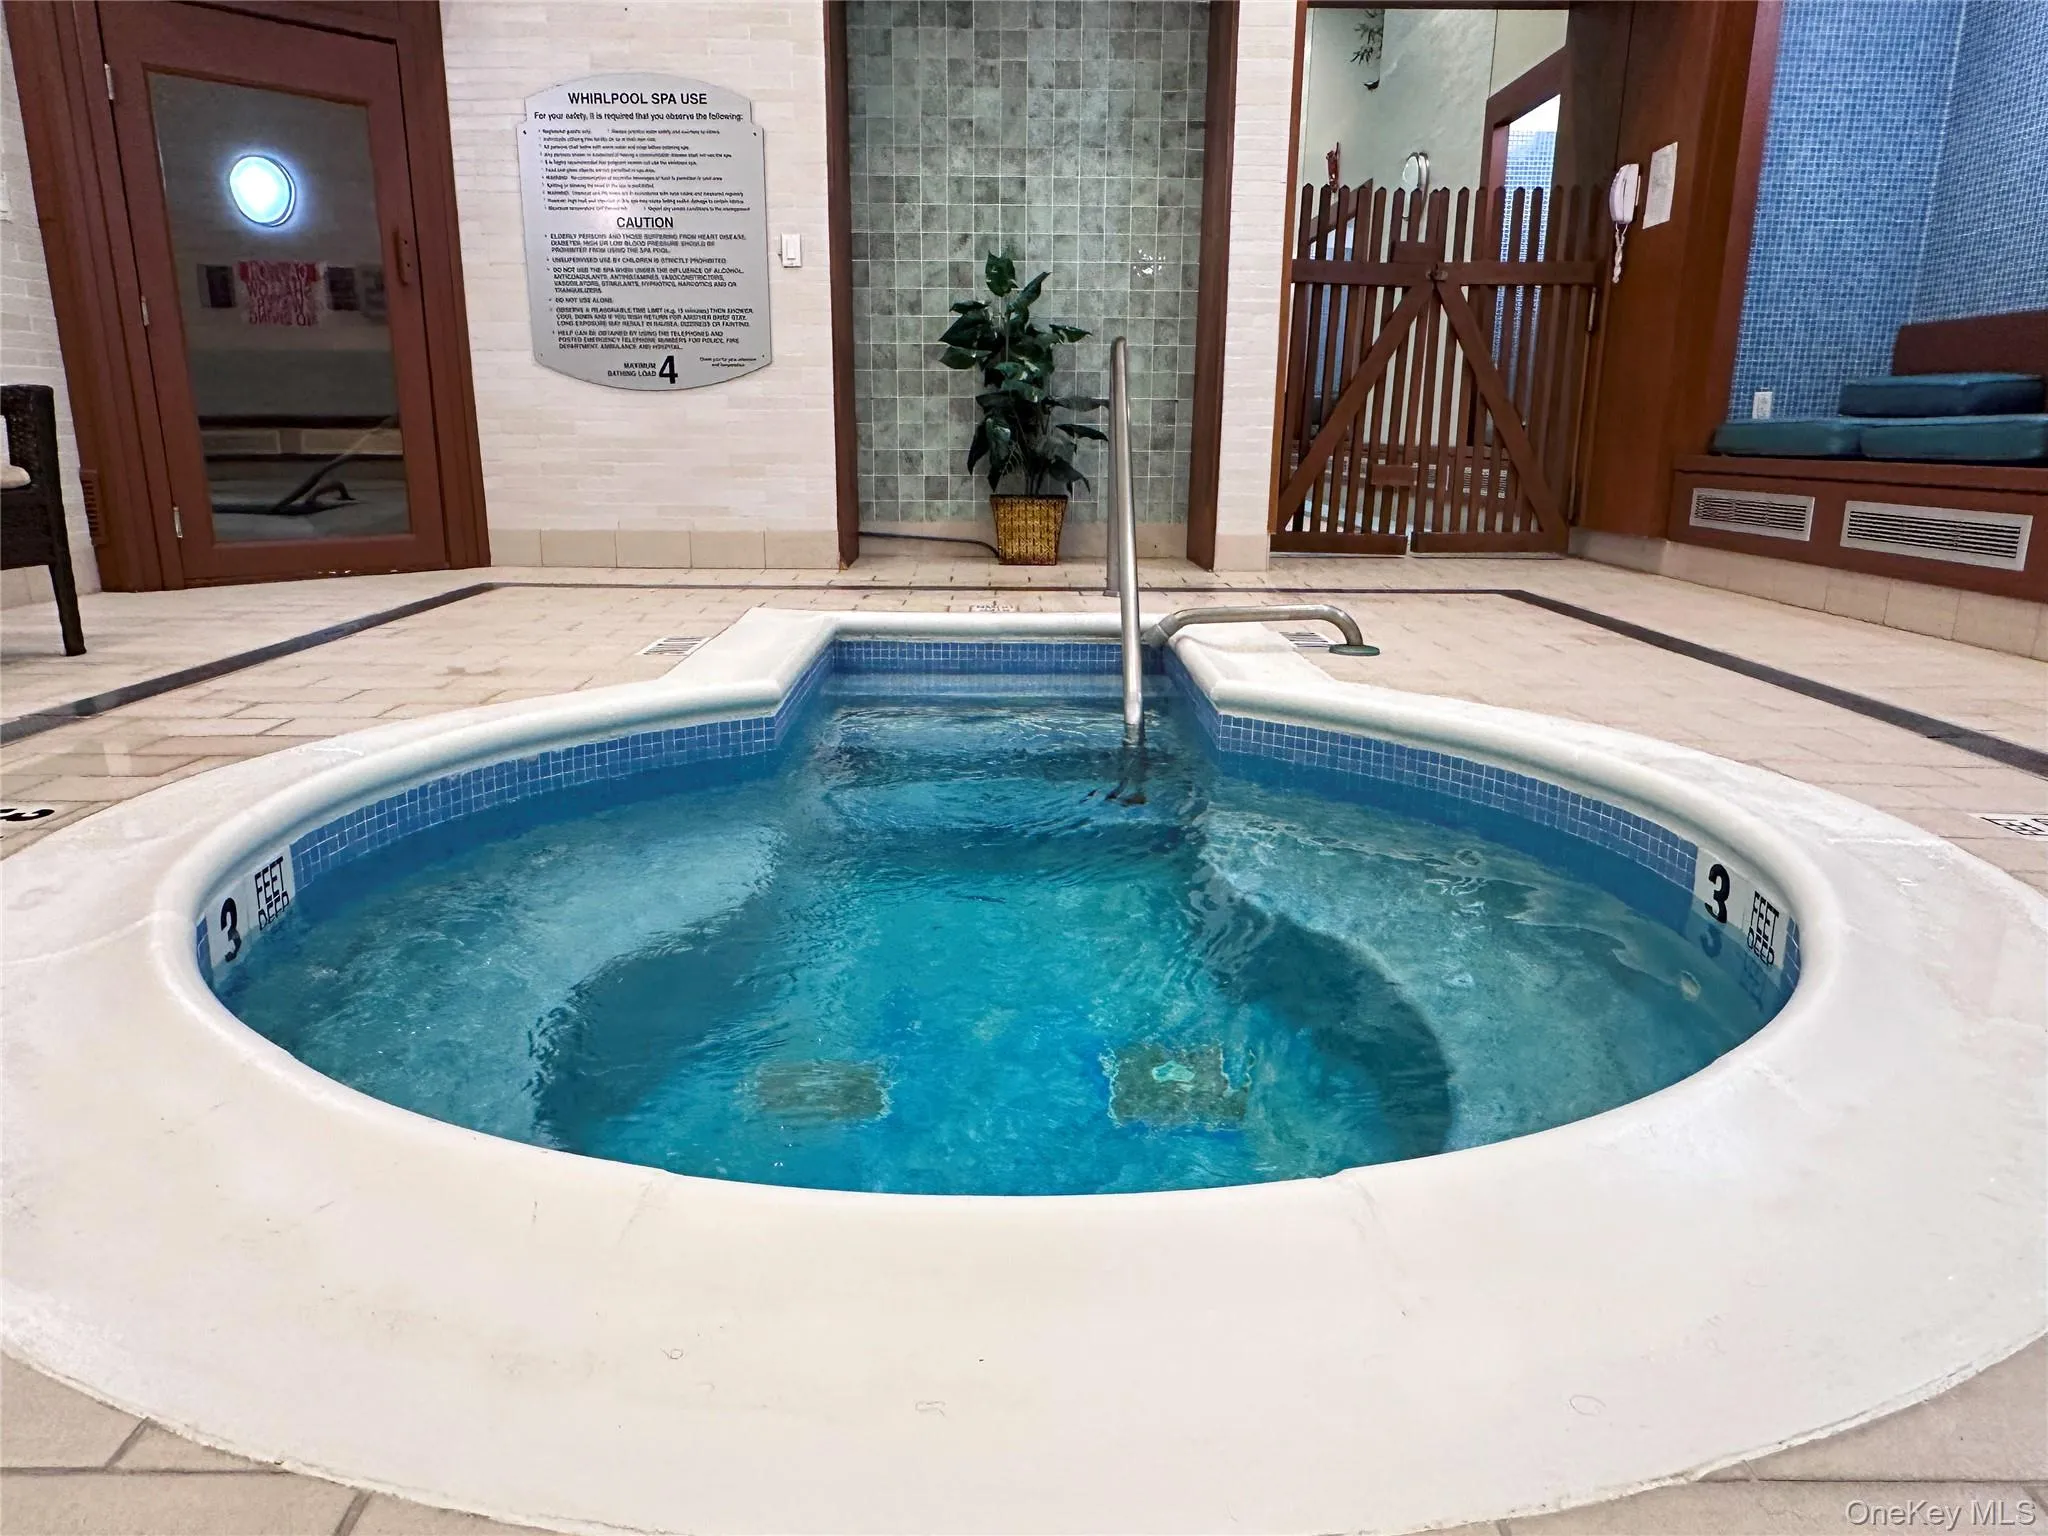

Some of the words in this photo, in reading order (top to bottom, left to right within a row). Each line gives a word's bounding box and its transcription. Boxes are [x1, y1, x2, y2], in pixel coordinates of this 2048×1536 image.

[534, 112, 546, 120] For
[548, 113, 563, 121] your
[596, 112, 602, 120] is
[604, 112, 634, 122] required
[650, 114, 664, 122] you
[568, 92, 648, 105] WHIRLPOOL
[651, 93, 677, 105] SPA
[680, 93, 707, 105] USE
[616, 217, 673, 228] CAUTION
[659, 355, 678, 385] 4
[255, 856, 283, 909] FEET
[1705, 864, 1730, 924] 3
[221, 898, 241, 963] 3
[1751, 891, 1779, 947] FEET
